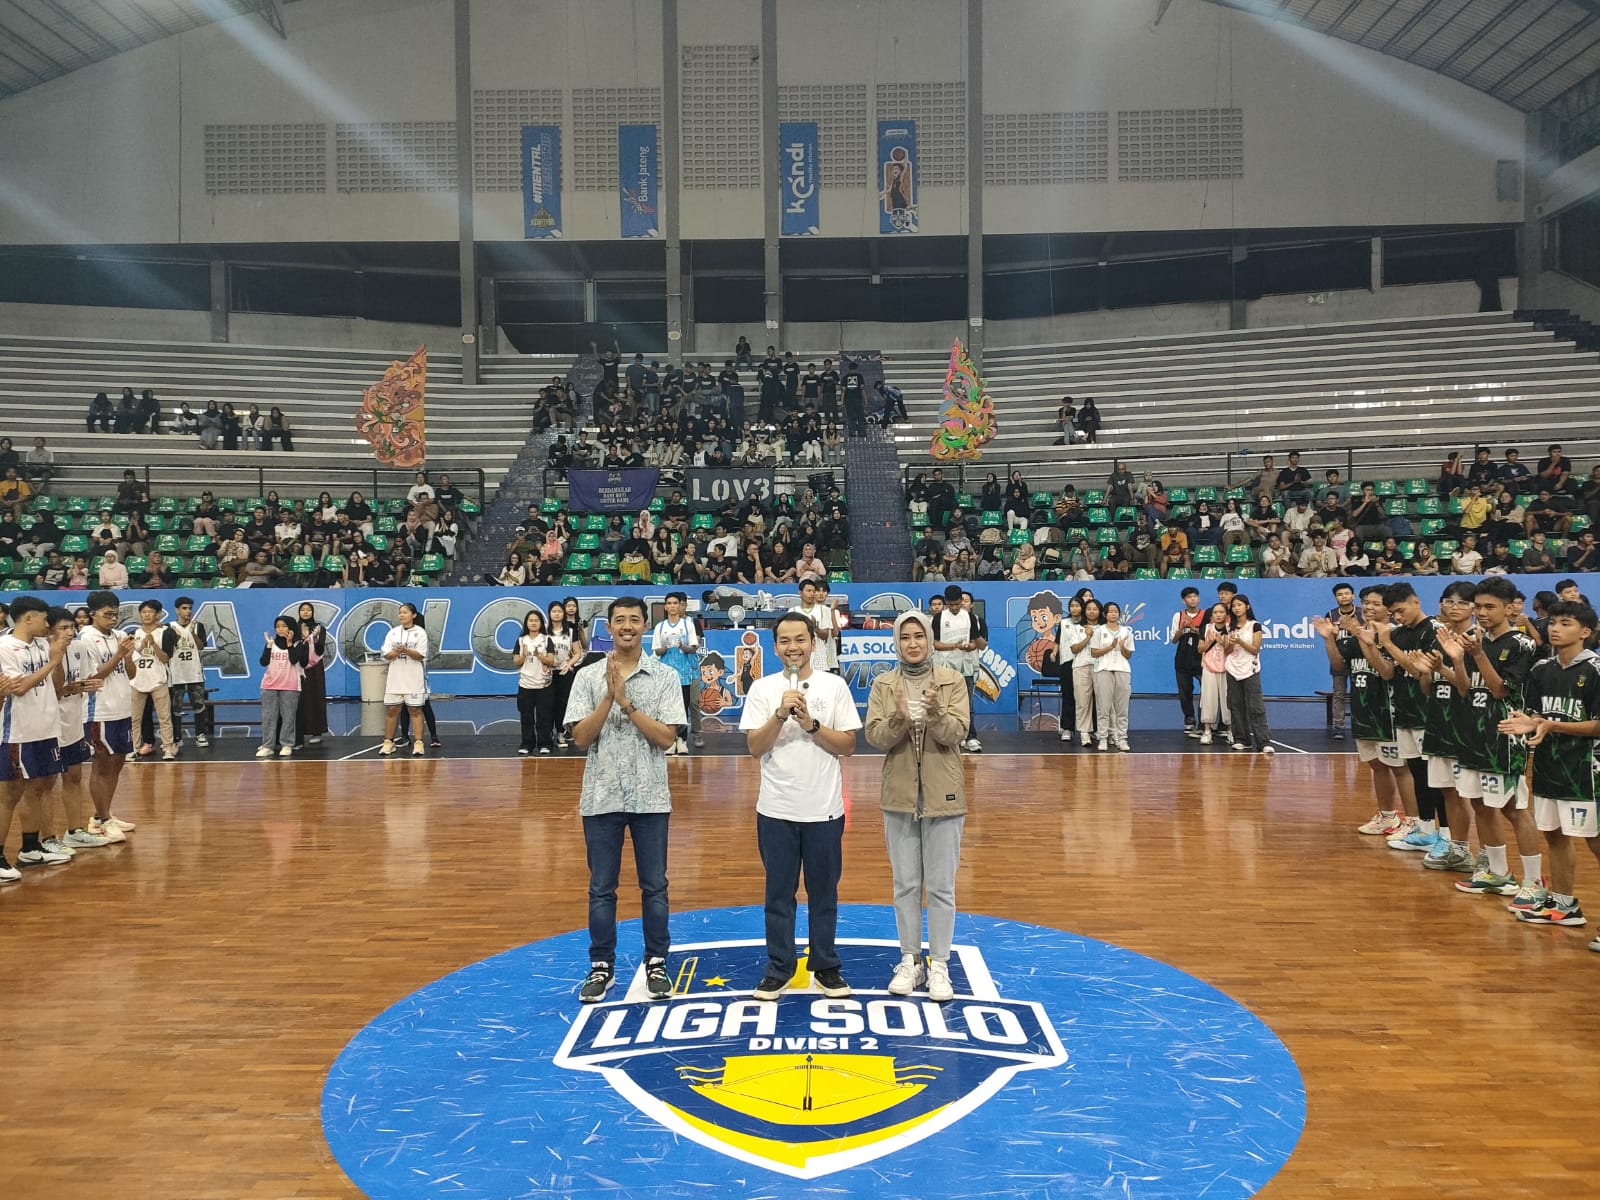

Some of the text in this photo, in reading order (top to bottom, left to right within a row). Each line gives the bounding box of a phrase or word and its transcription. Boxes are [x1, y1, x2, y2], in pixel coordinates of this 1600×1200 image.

[531, 143, 543, 204] #MENTAL
[638, 146, 650, 202] Bank Jateng
[786, 143, 815, 213] kandi
[692, 478, 770, 502] LOV3
[1129, 626, 1161, 641] ank
[1261, 616, 1315, 639] ndi
[138, 659, 154, 669] 87
[178, 651, 193, 661] 42
[1355, 674, 1368, 688] 55
[1436, 684, 1451, 699] 29
[1472, 692, 1488, 708] 22
[1381, 746, 1399, 759] 55
[1481, 774, 1499, 794] 22
[1570, 807, 1587, 827] 17
[591, 999, 1029, 1049] LIGA SOLO
[748, 1037, 879, 1051] DIVISI 2
